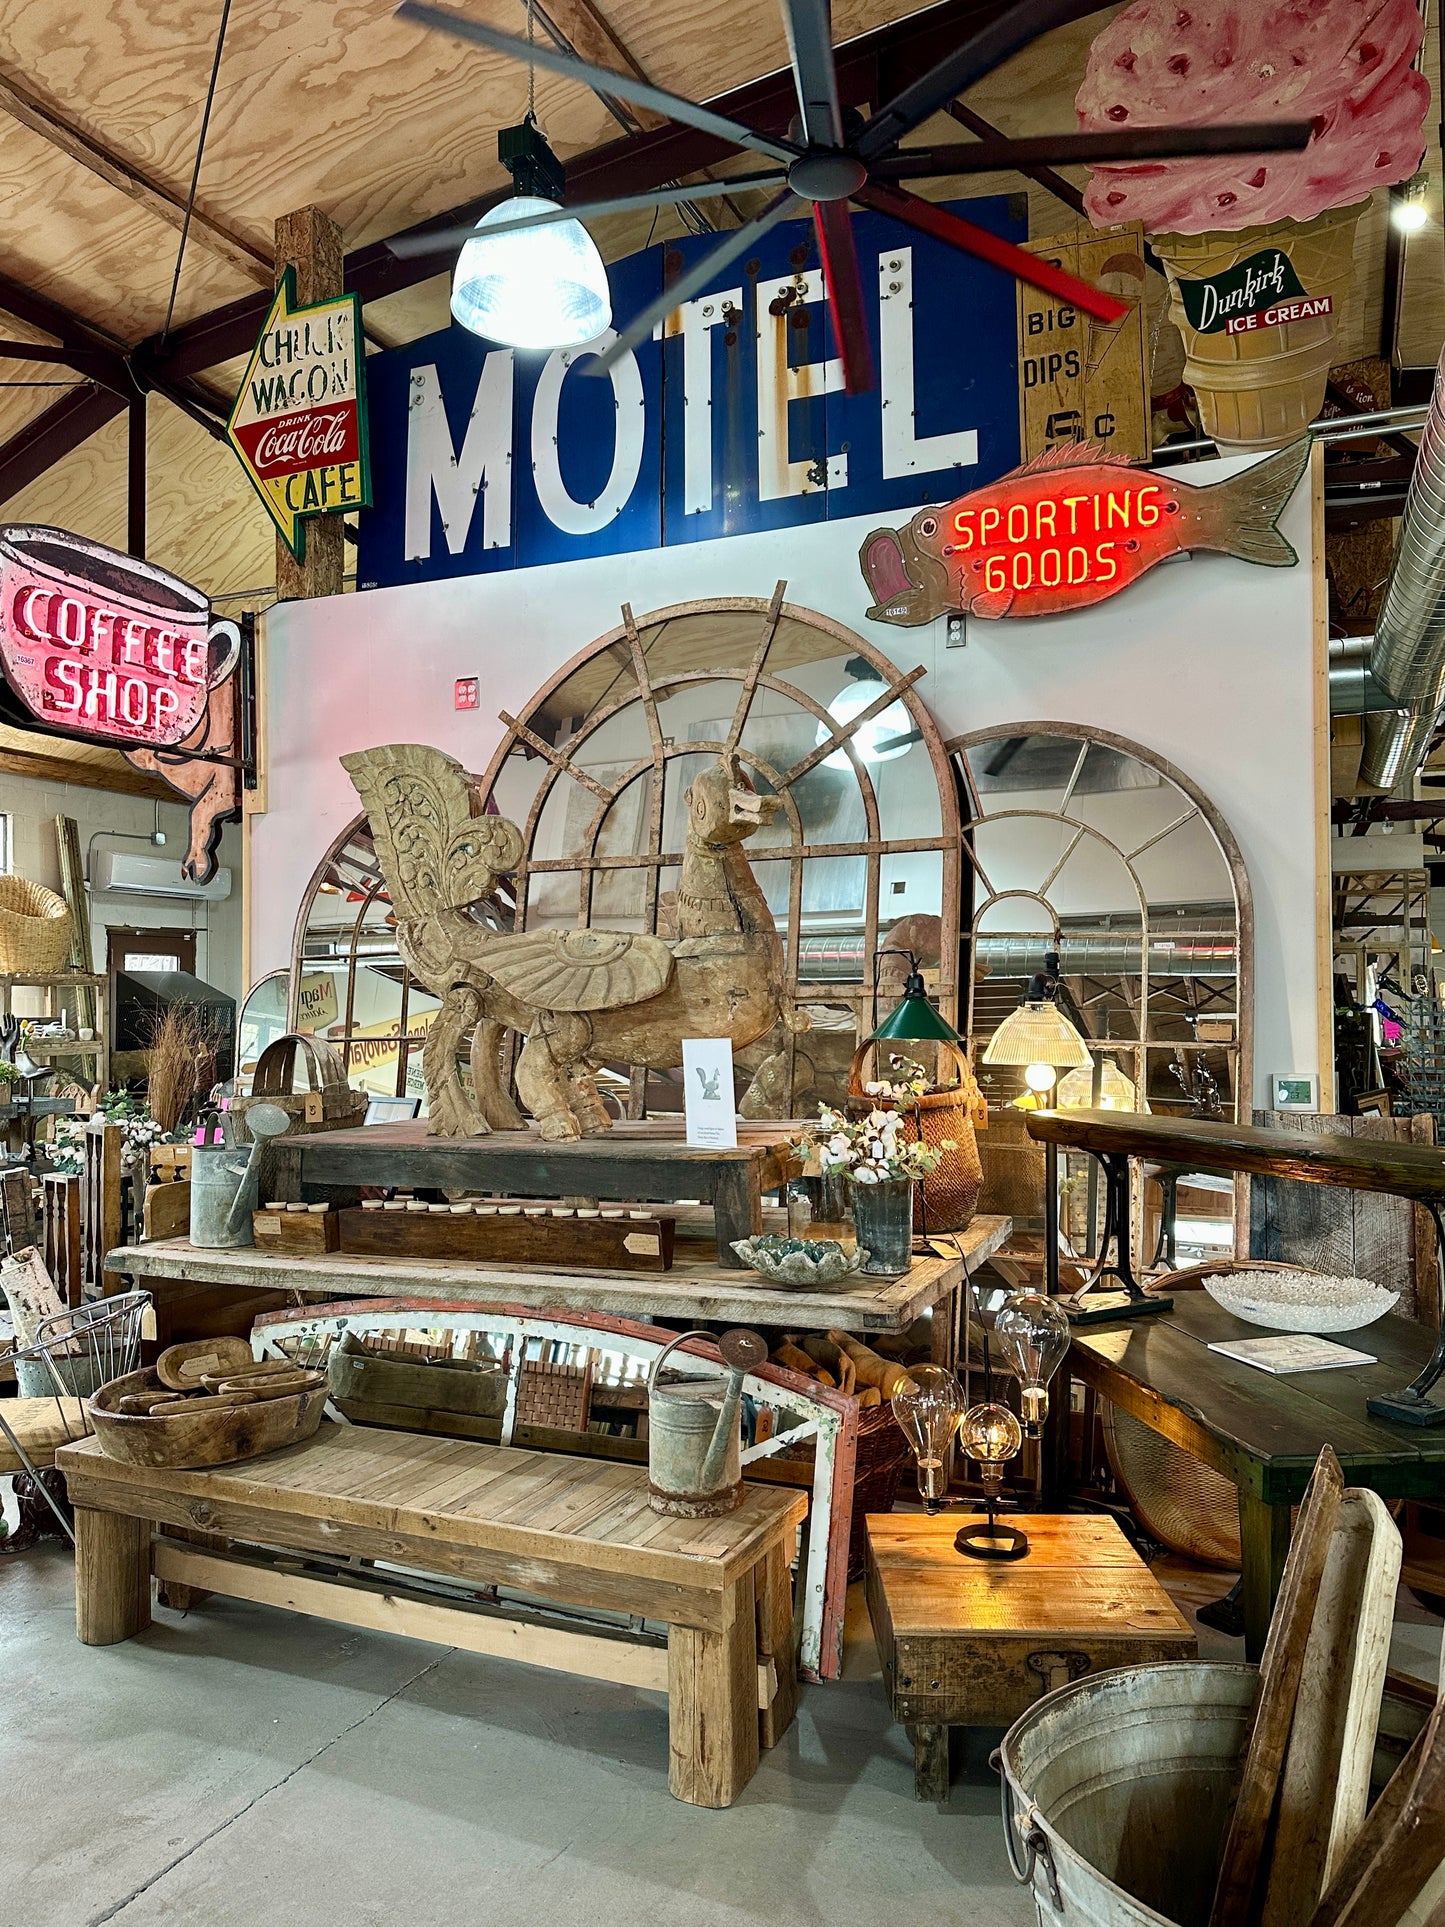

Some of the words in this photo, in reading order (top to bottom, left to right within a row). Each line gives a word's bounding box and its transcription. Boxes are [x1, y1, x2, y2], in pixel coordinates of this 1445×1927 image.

[1198, 253, 1286, 331] Dunkirk
[1228, 314, 1258, 334] ICE
[1264, 298, 1331, 326] CREAM
[1028, 306, 1076, 336] BIG
[1023, 350, 1080, 389] DIPS
[276, 413, 313, 430] DRINK
[404, 246, 979, 562] MOTEL
[254, 409, 351, 469] Coca-Cola
[284, 463, 357, 512] CAFE
[953, 486, 1160, 551] SPORTING
[985, 541, 1117, 593] GOODS
[13, 585, 209, 686] COFFEE
[45, 656, 180, 730] SHOP
